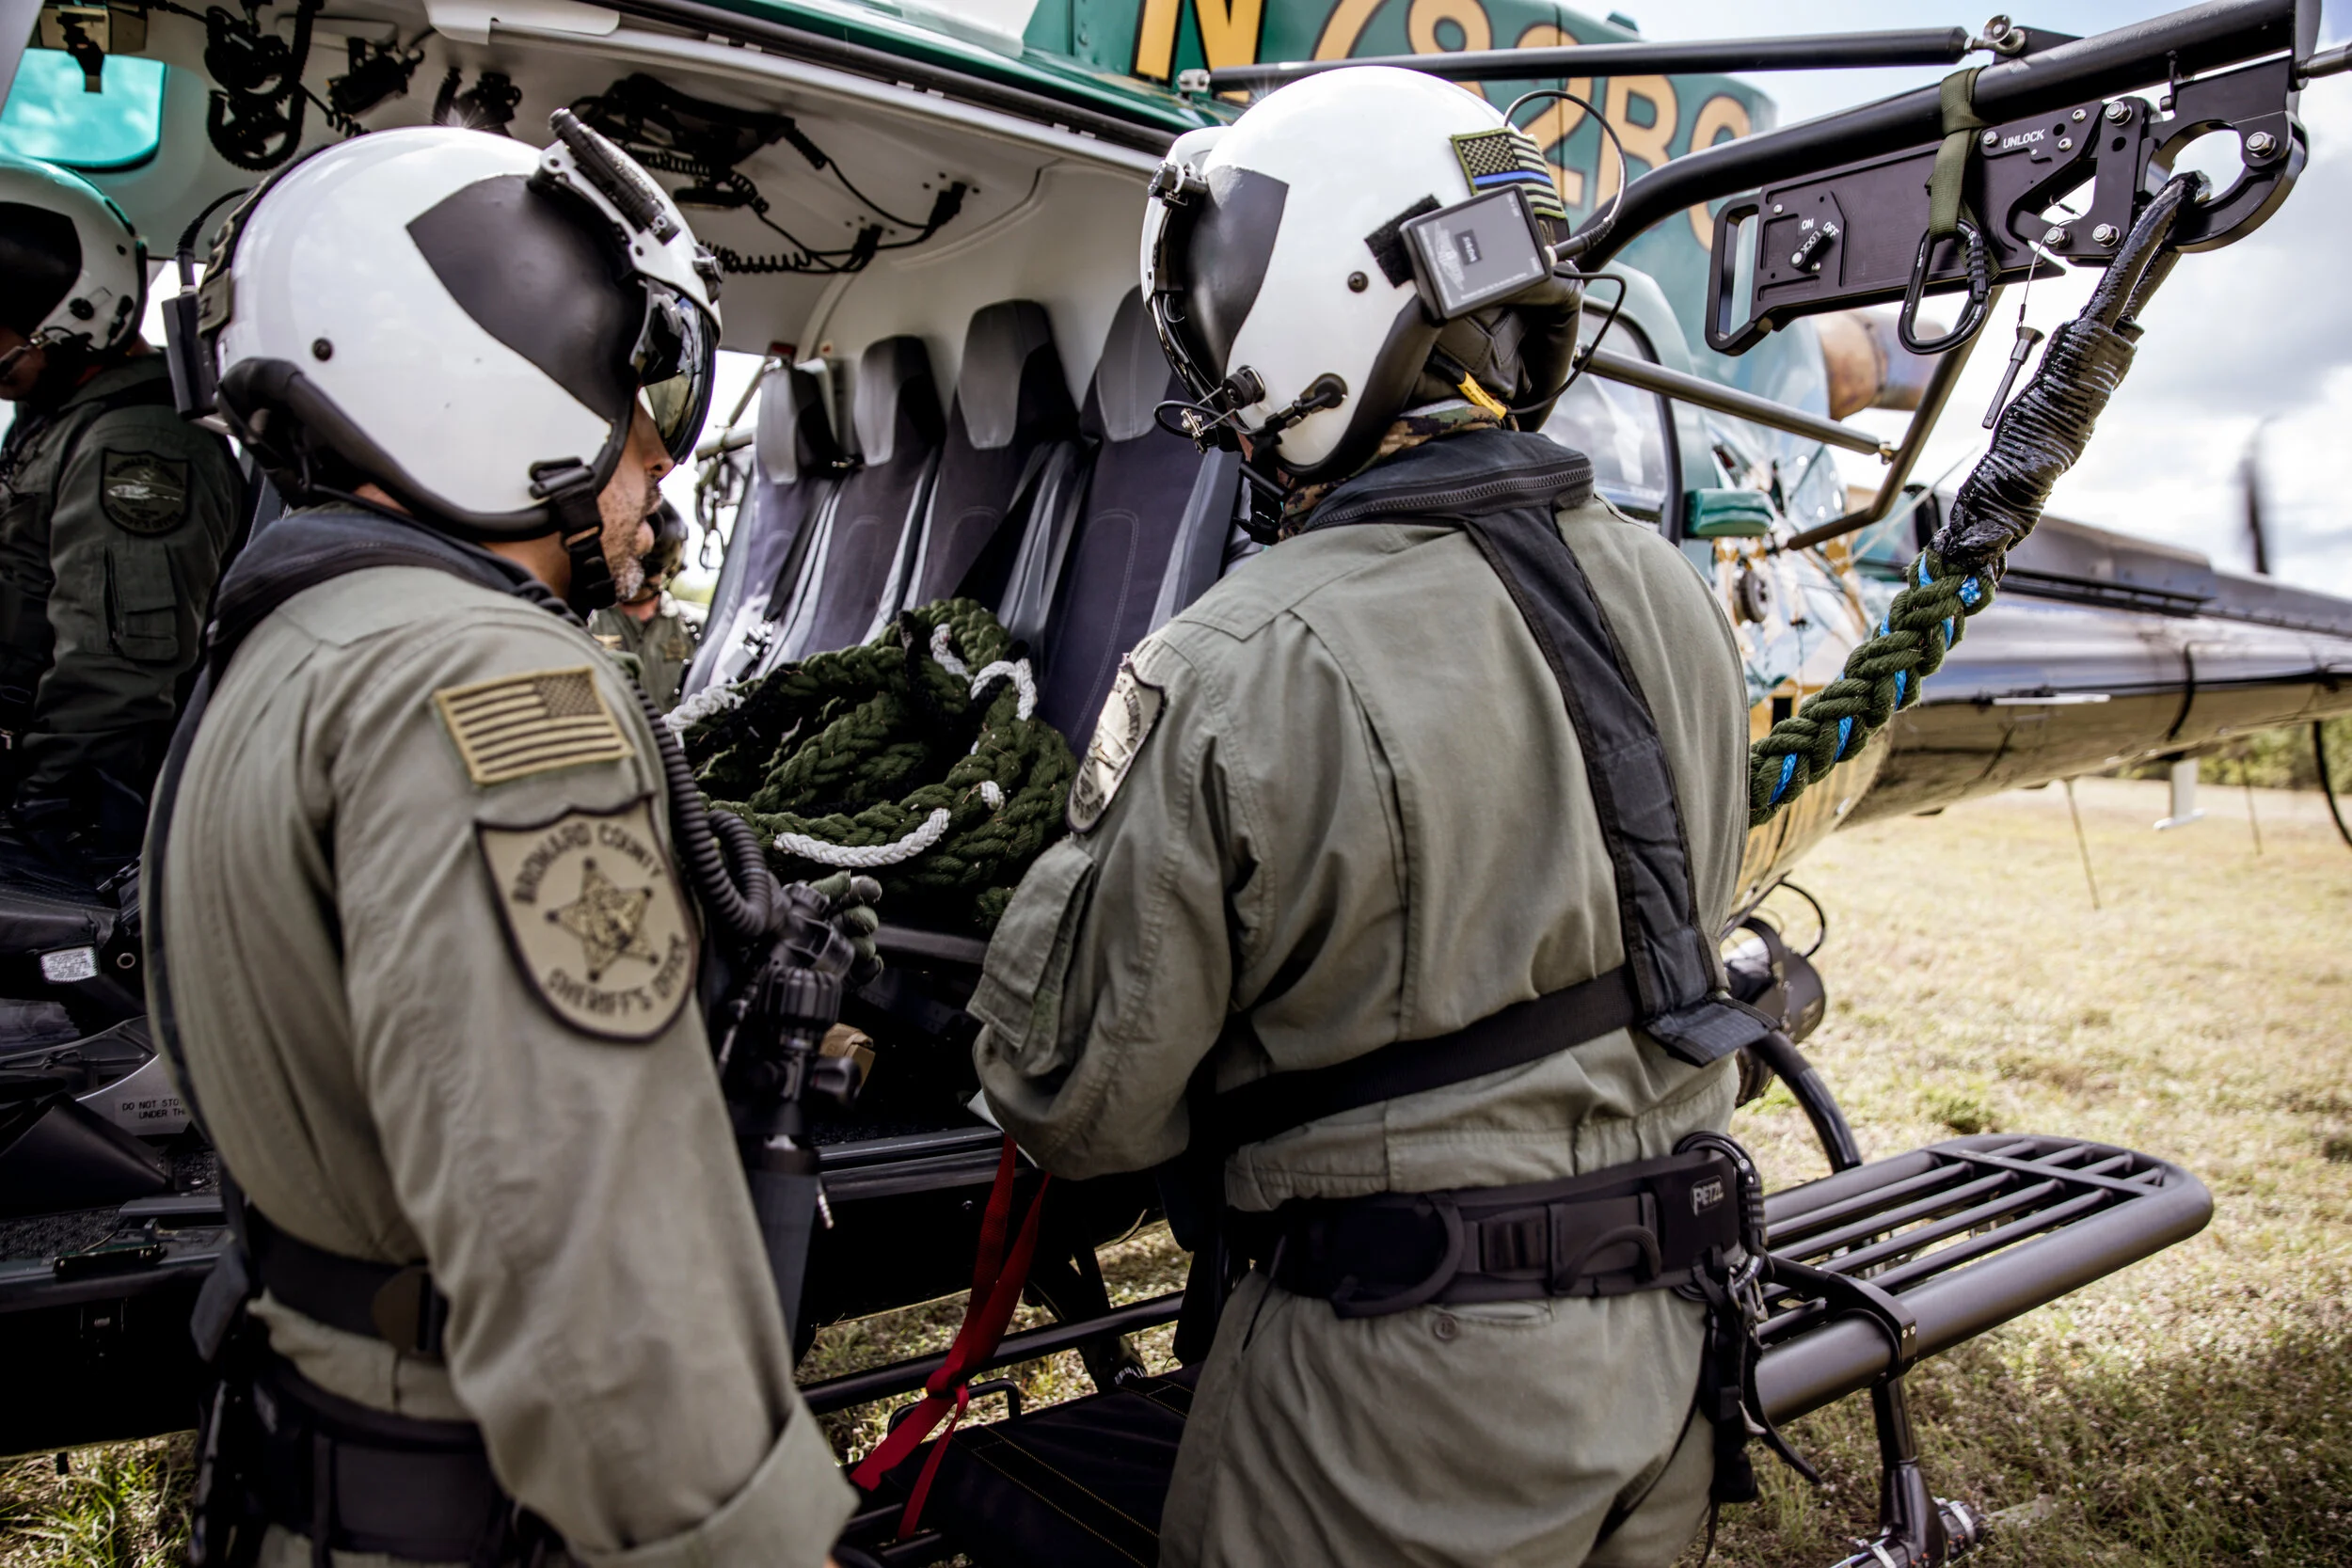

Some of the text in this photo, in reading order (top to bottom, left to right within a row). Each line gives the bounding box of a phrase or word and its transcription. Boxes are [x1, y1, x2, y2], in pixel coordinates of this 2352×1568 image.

[2003, 129, 2045, 149] UNLOCK
[1802, 218, 1814, 230] ON
[1822, 221, 1839, 237] OFF
[1801, 230, 1820, 254] LOCK
[122, 1098, 180, 1111] DO NOT STO
[138, 1109, 167, 1119] UNDER
[1693, 1180, 1724, 1216] PETZL
